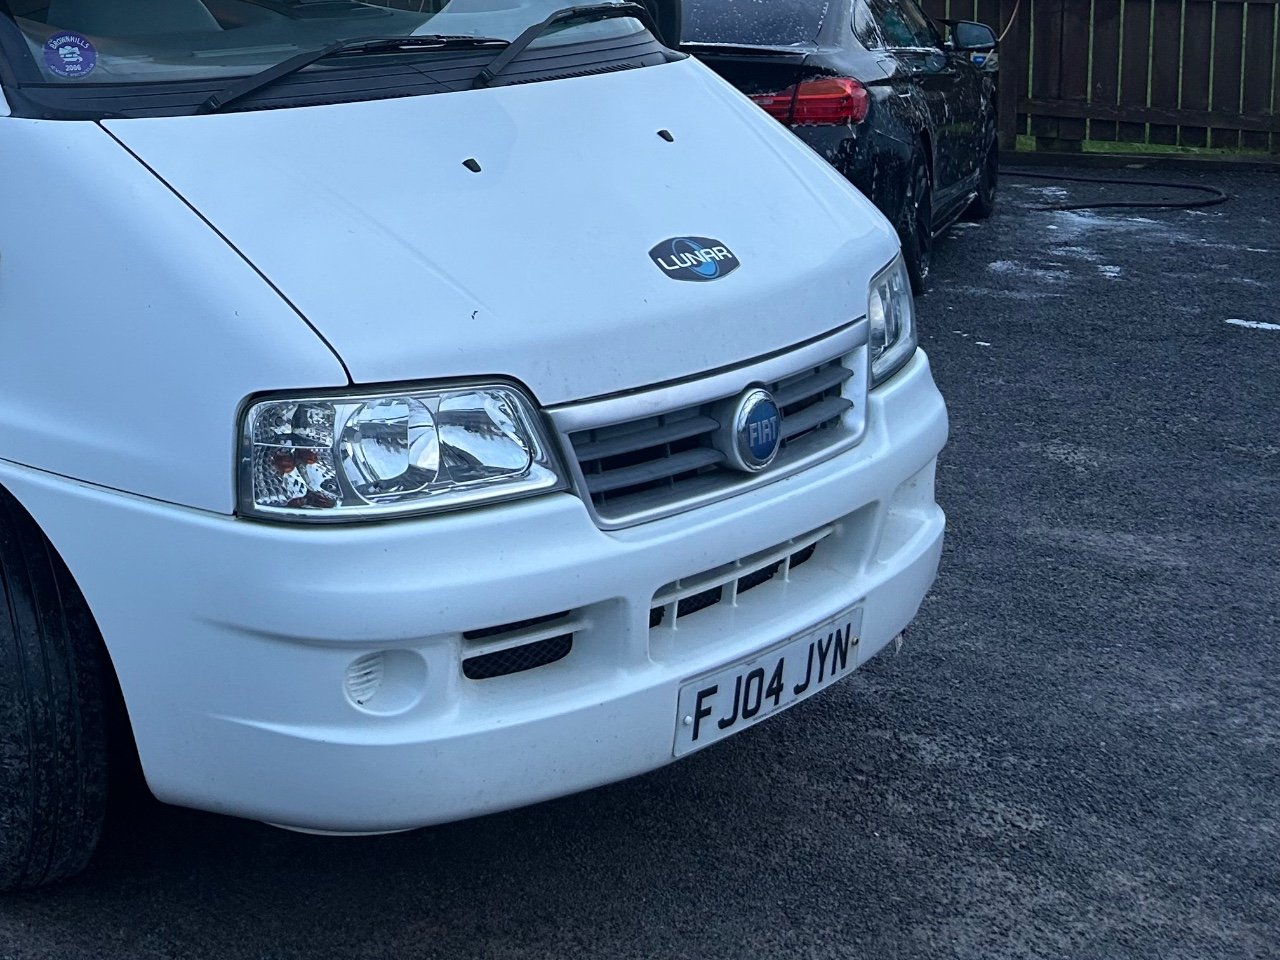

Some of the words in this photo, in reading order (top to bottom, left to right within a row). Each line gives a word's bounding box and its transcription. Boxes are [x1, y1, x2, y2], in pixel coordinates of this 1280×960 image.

[657, 246, 733, 271] LUNAR
[749, 415, 777, 448] FIAT
[692, 656, 785, 742] FJ04
[793, 622, 852, 696] JYN
